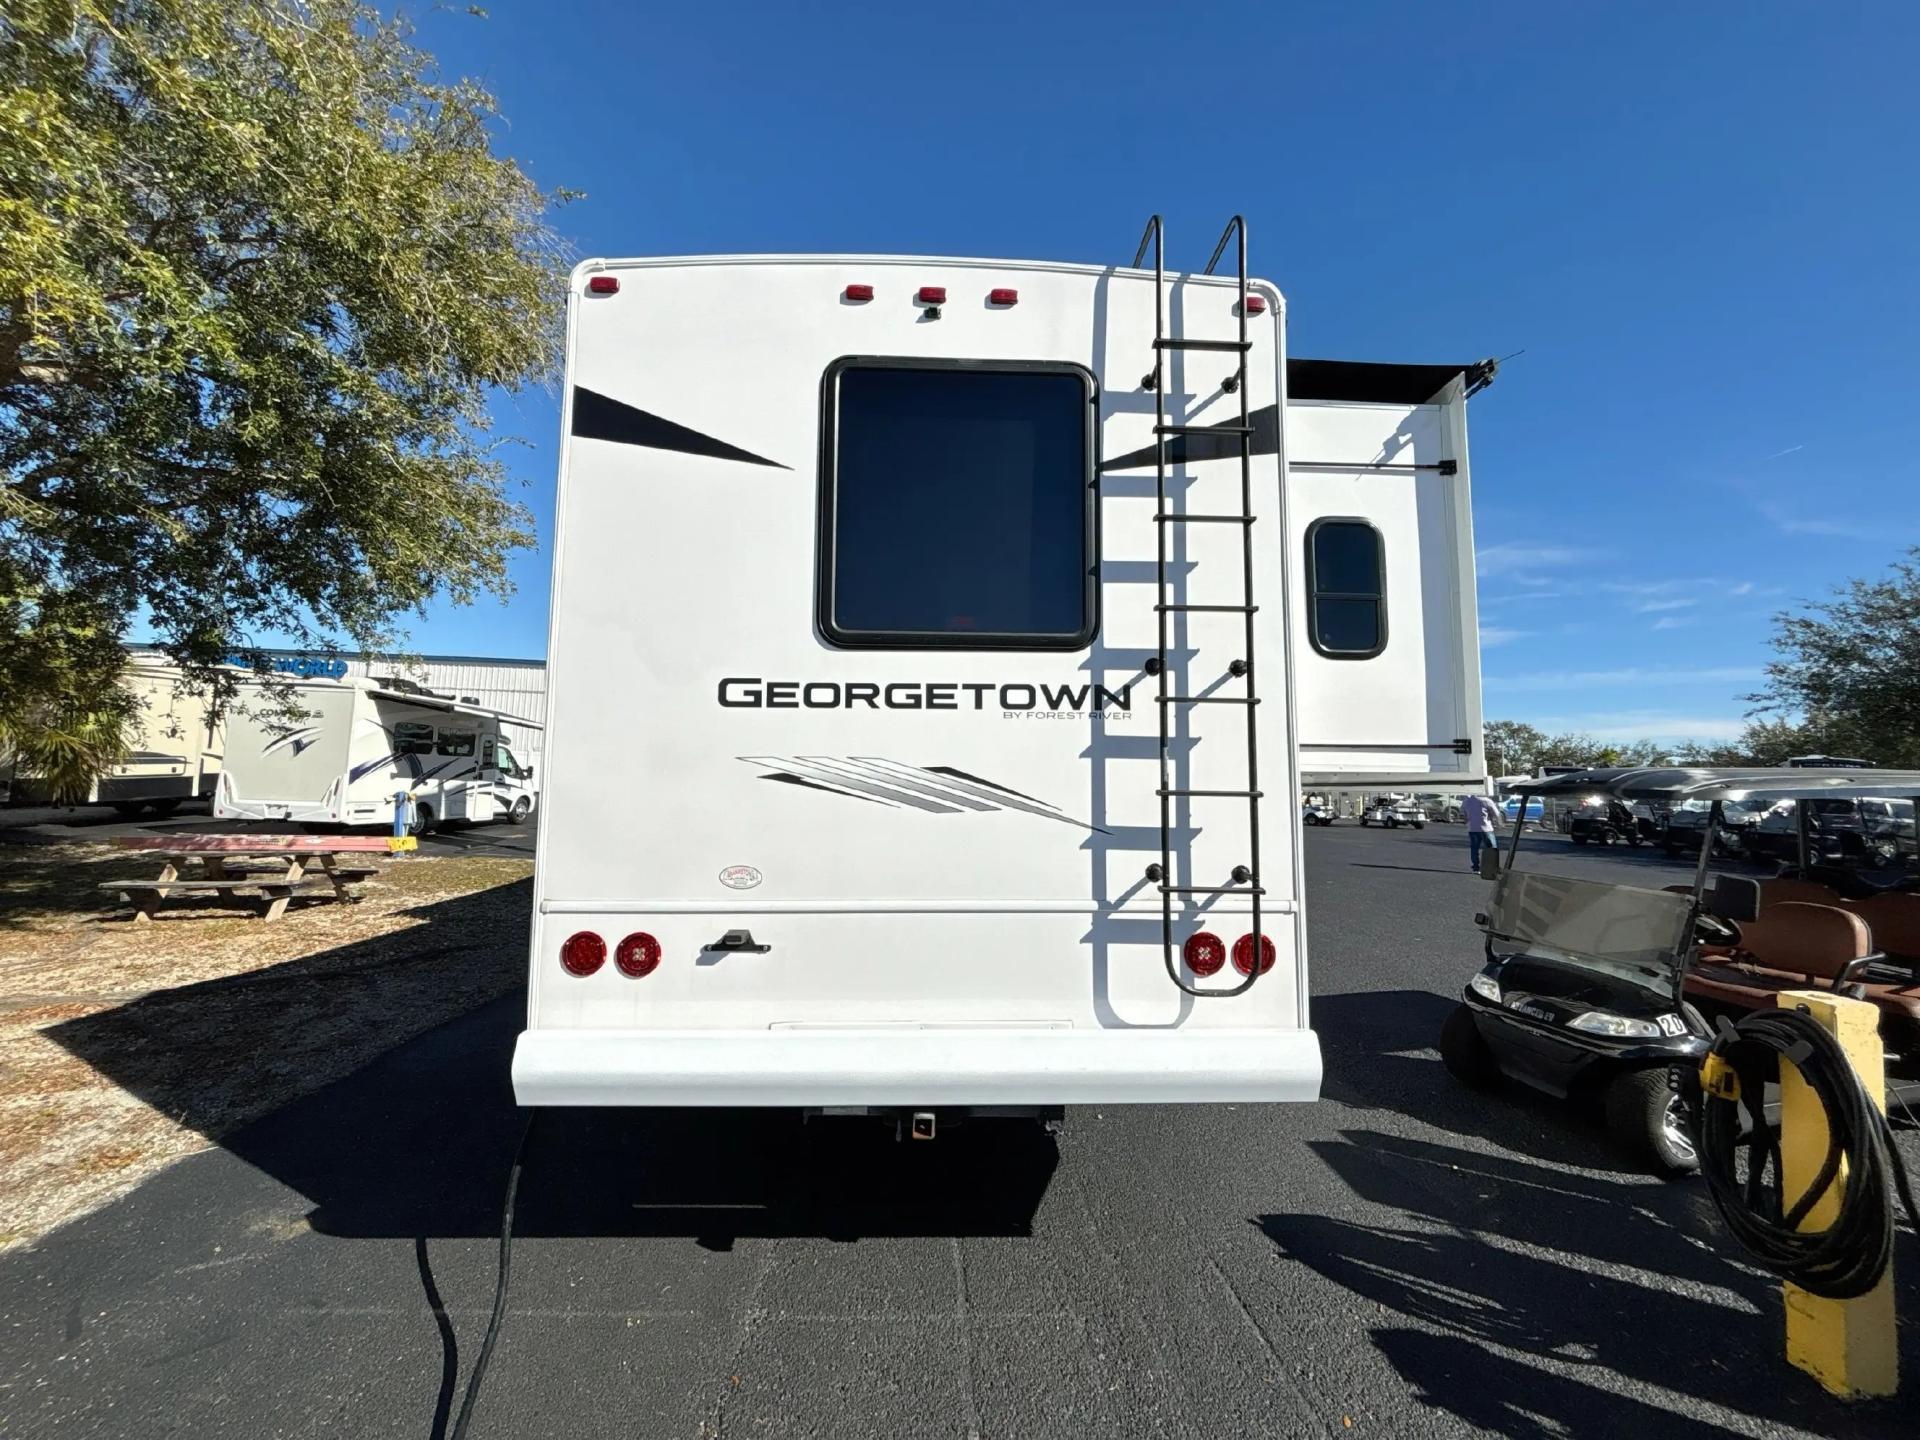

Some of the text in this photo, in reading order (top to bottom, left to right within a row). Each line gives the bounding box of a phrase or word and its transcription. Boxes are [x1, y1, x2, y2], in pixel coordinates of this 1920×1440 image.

[718, 677, 1131, 711] GEORGETOWN
[1003, 711, 1132, 720] BY FOREST RIVER
[1660, 1014, 1685, 1036] 20
